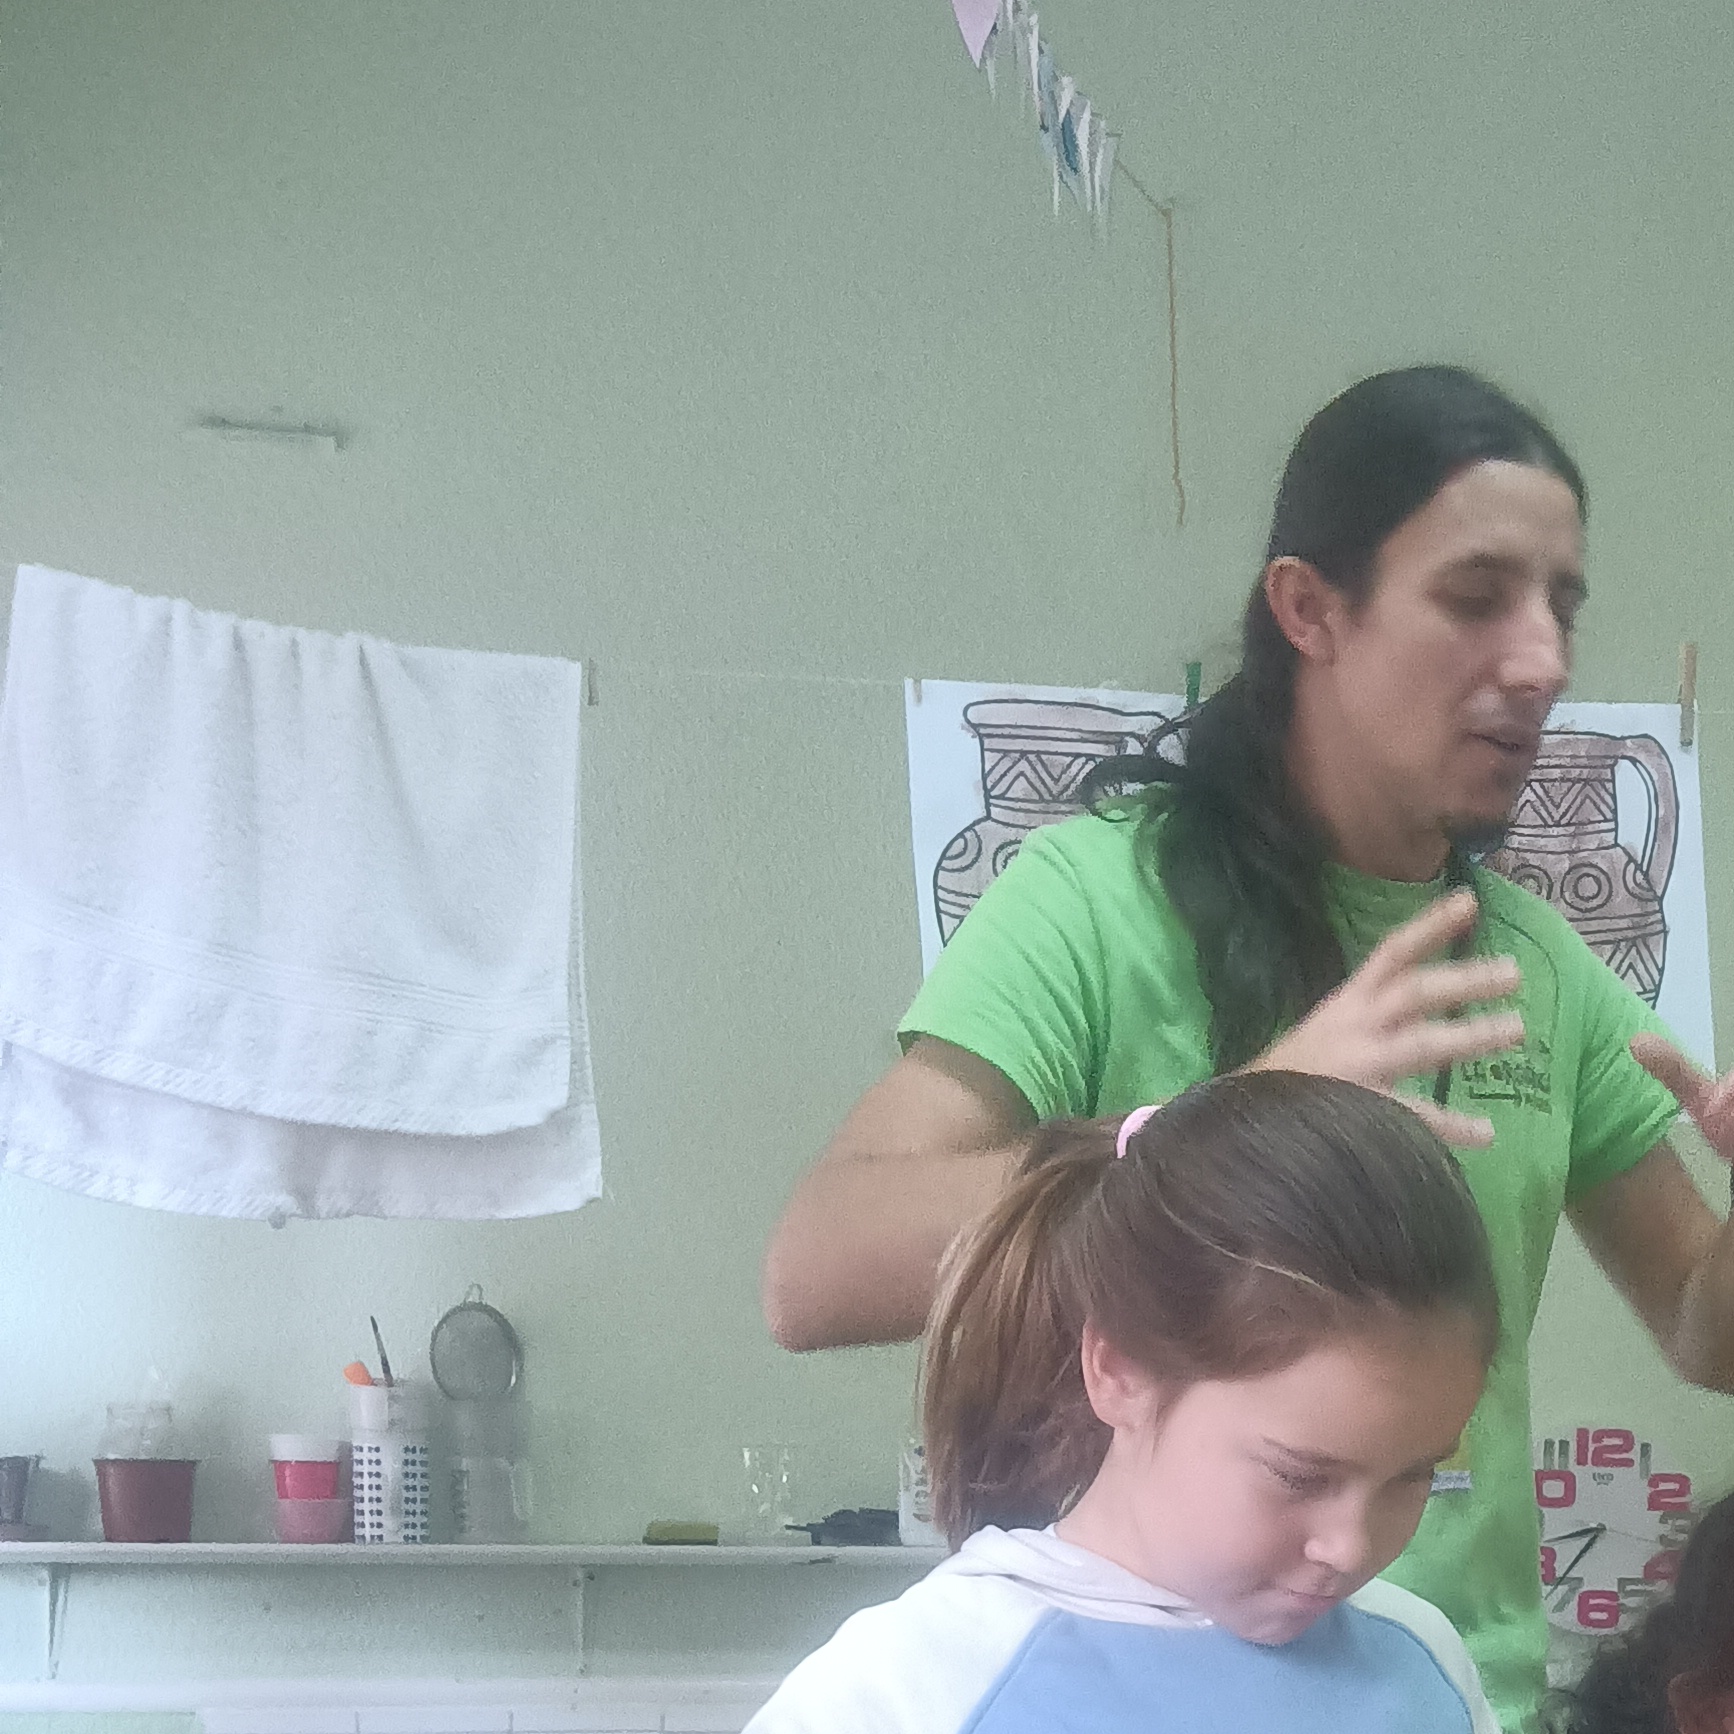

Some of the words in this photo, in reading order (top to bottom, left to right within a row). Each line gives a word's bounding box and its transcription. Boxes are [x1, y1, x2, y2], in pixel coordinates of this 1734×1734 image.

[1574, 1427, 1636, 1468] 12
[1647, 1473, 1692, 1512] 2
[1577, 1589, 1621, 1629] 6
